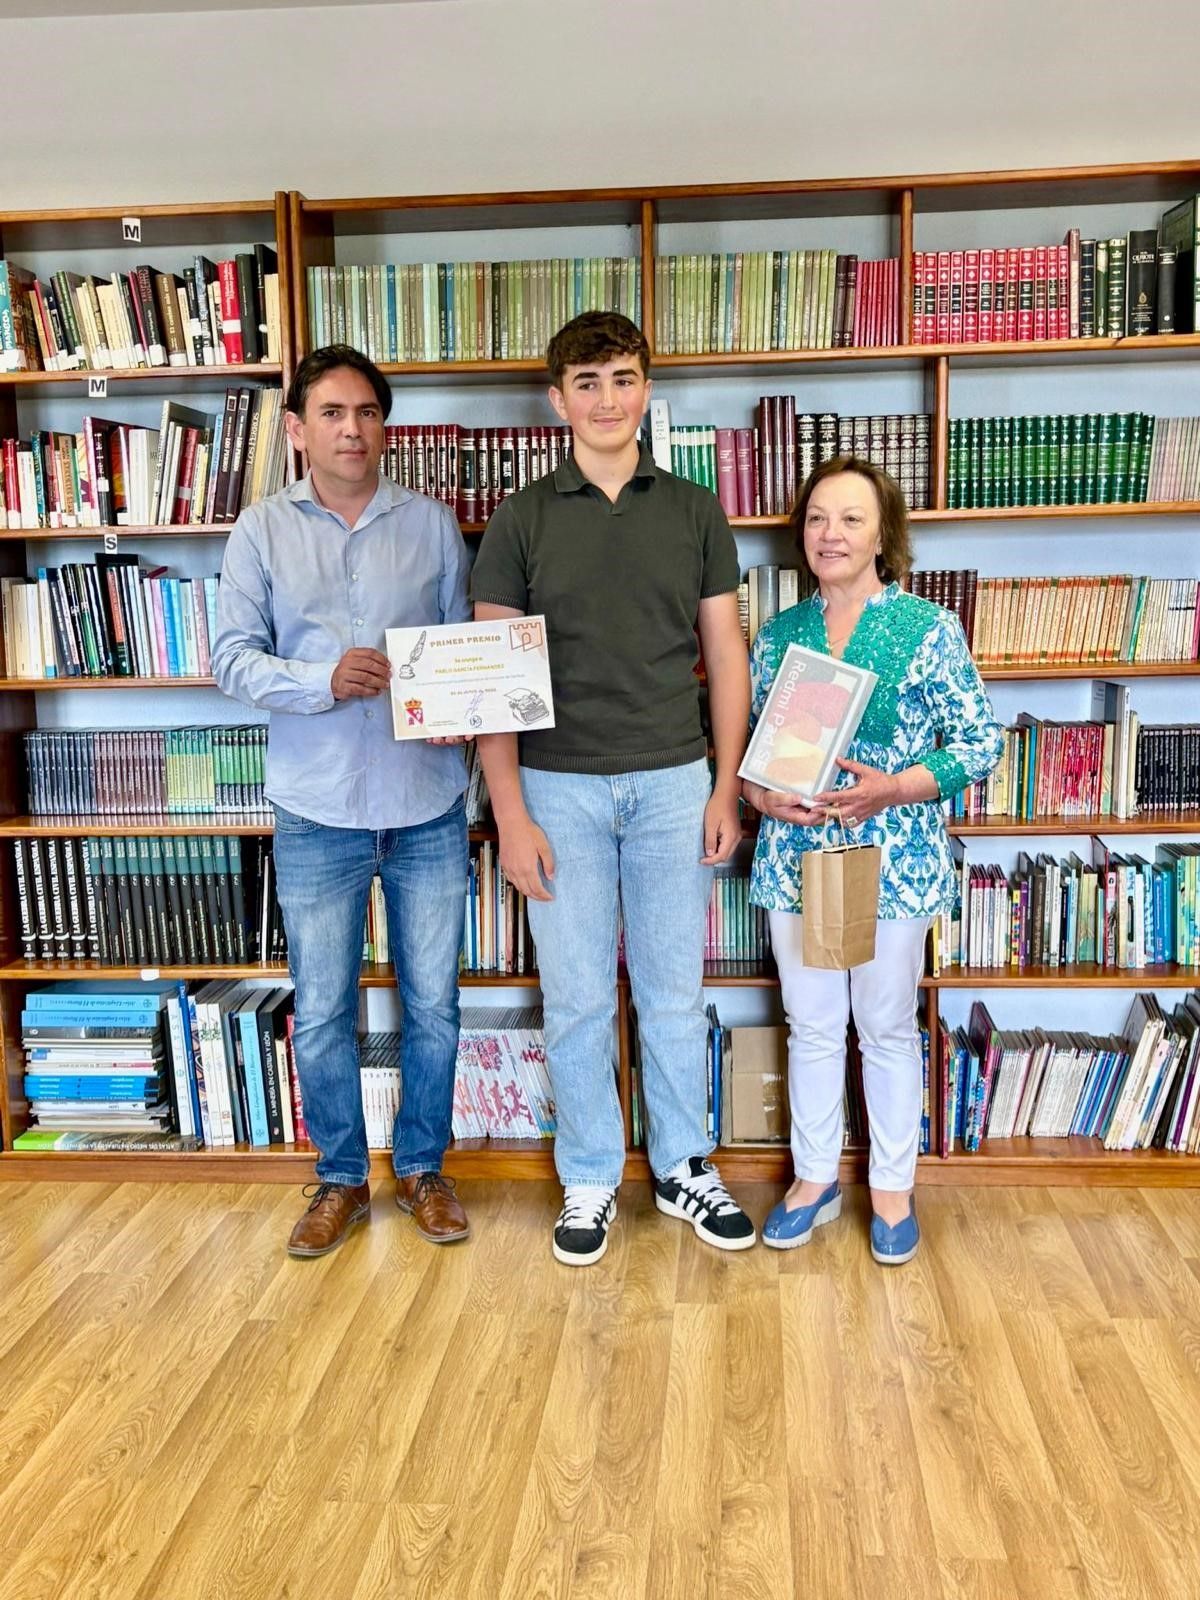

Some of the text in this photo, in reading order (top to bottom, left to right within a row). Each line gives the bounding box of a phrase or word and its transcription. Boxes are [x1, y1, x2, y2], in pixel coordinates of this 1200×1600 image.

[124, 224, 139, 238] M
[90, 379, 105, 391] M
[249, 413, 260, 446] PERROS
[106, 536, 117, 550] S
[430, 635, 501, 648] PRIMER PREMIO
[751, 660, 807, 771] Redmi Pad SE
[15, 840, 24, 874] ESPAÑOLA
[48, 840, 57, 874] ESPAÑOLA
[31, 840, 48, 933] LA GUERRA CIVIL ESPAÑOLA
[65, 840, 80, 933] LA GUERRA CIVIL ESPAÑOLA
[54, 896, 62, 923] GUERRA
[87, 896, 96, 923] GUERRA
[23, 924, 30, 933] LA
[56, 924, 63, 933] LA
[90, 924, 97, 933] LA
[268, 1077, 275, 1085] EN
[293, 1080, 302, 1103] VIDA
[268, 1086, 276, 1109] MINERÍA
[296, 1106, 303, 1120] LA
